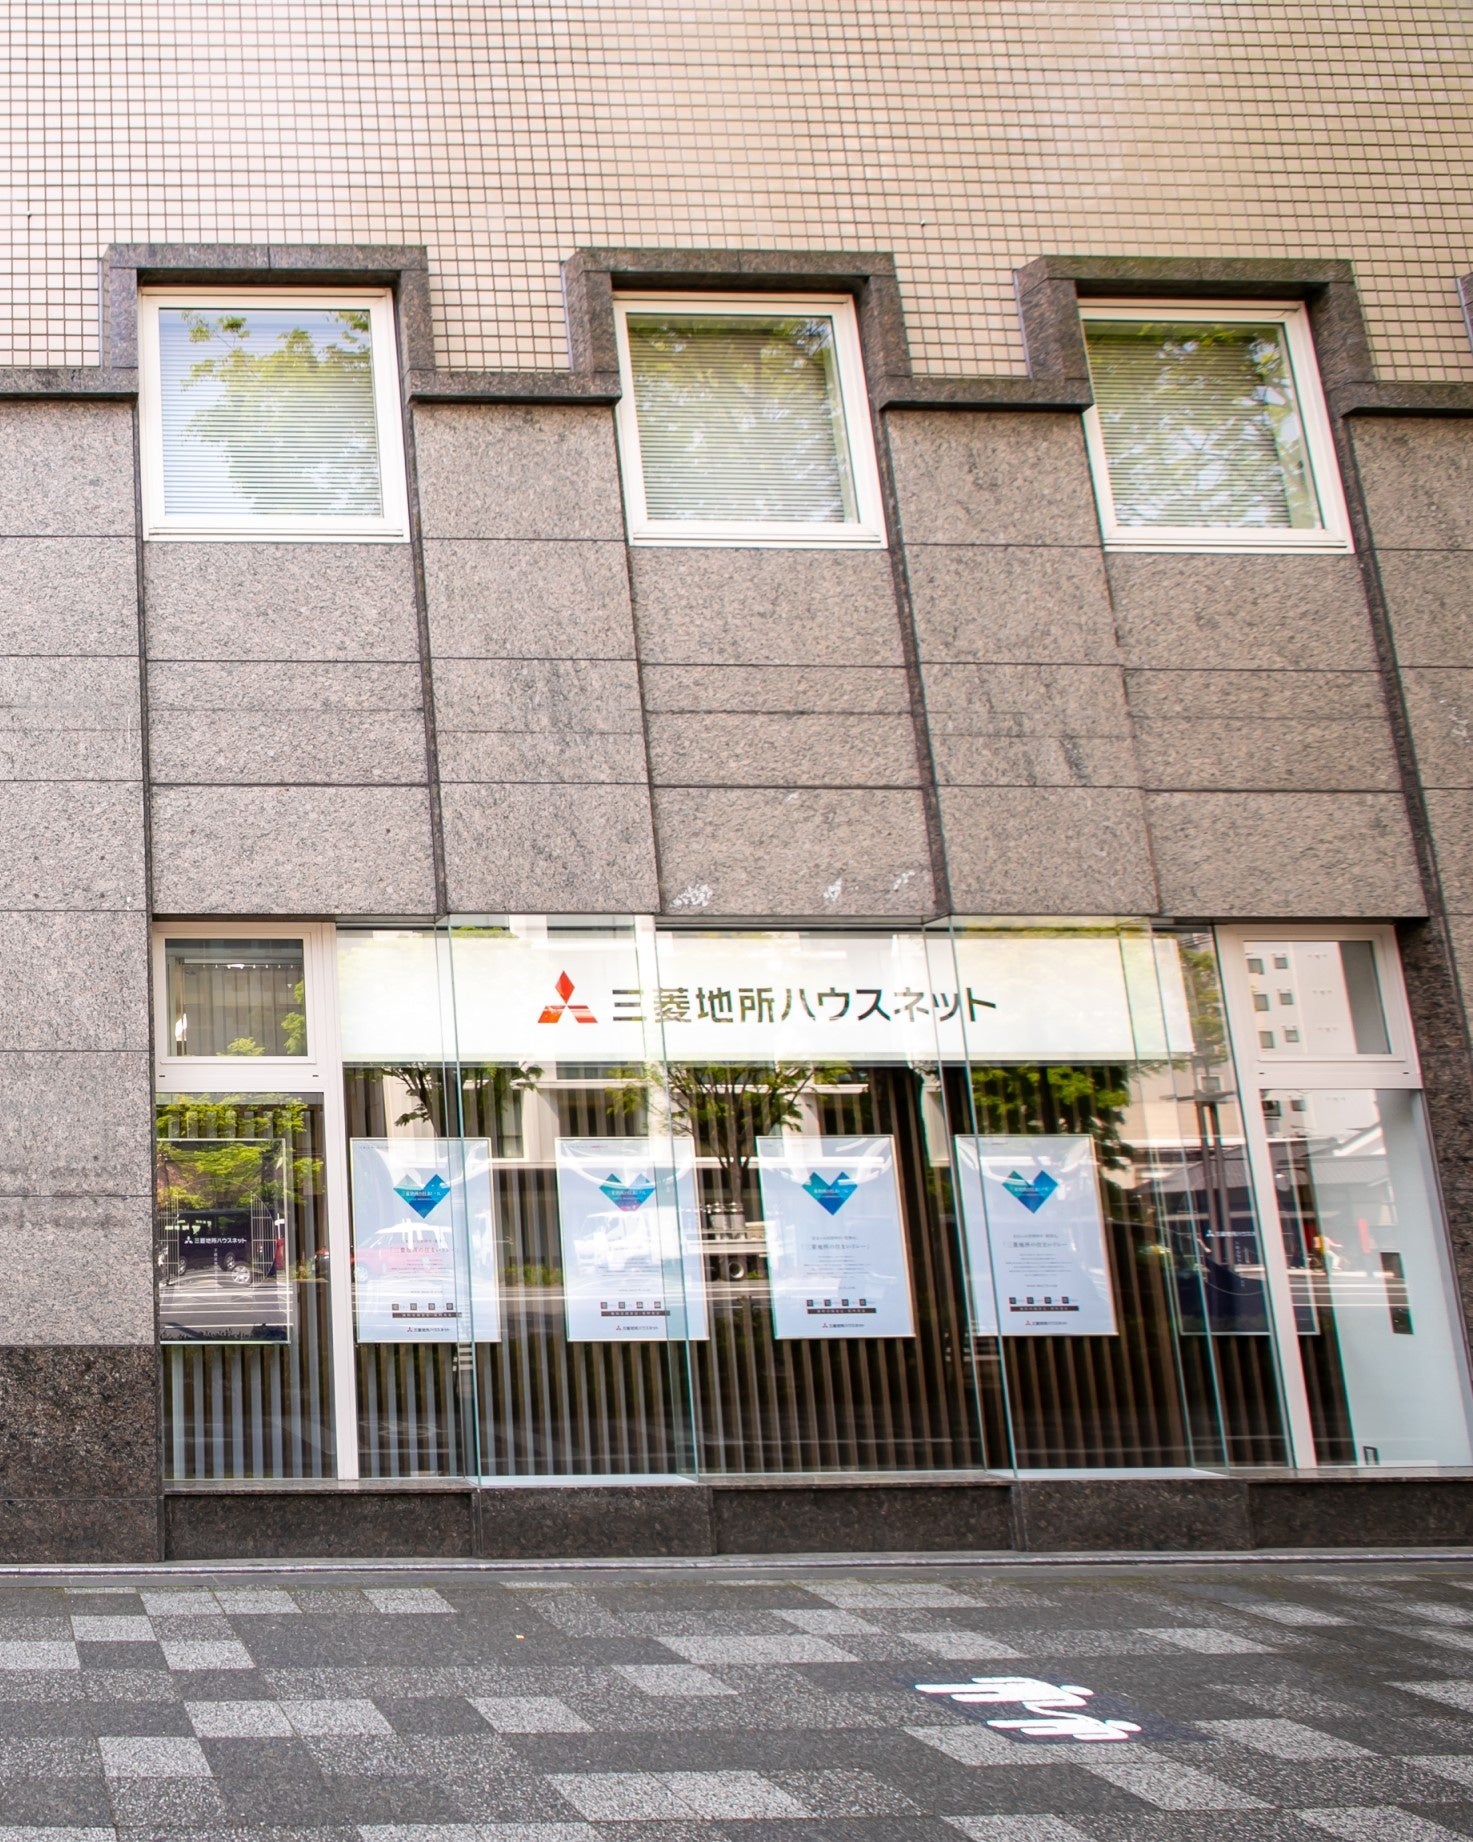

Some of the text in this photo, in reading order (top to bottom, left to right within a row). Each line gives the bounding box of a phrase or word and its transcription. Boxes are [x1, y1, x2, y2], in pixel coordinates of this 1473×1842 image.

[612, 986, 997, 1024] 三菱地所ハウスネット
